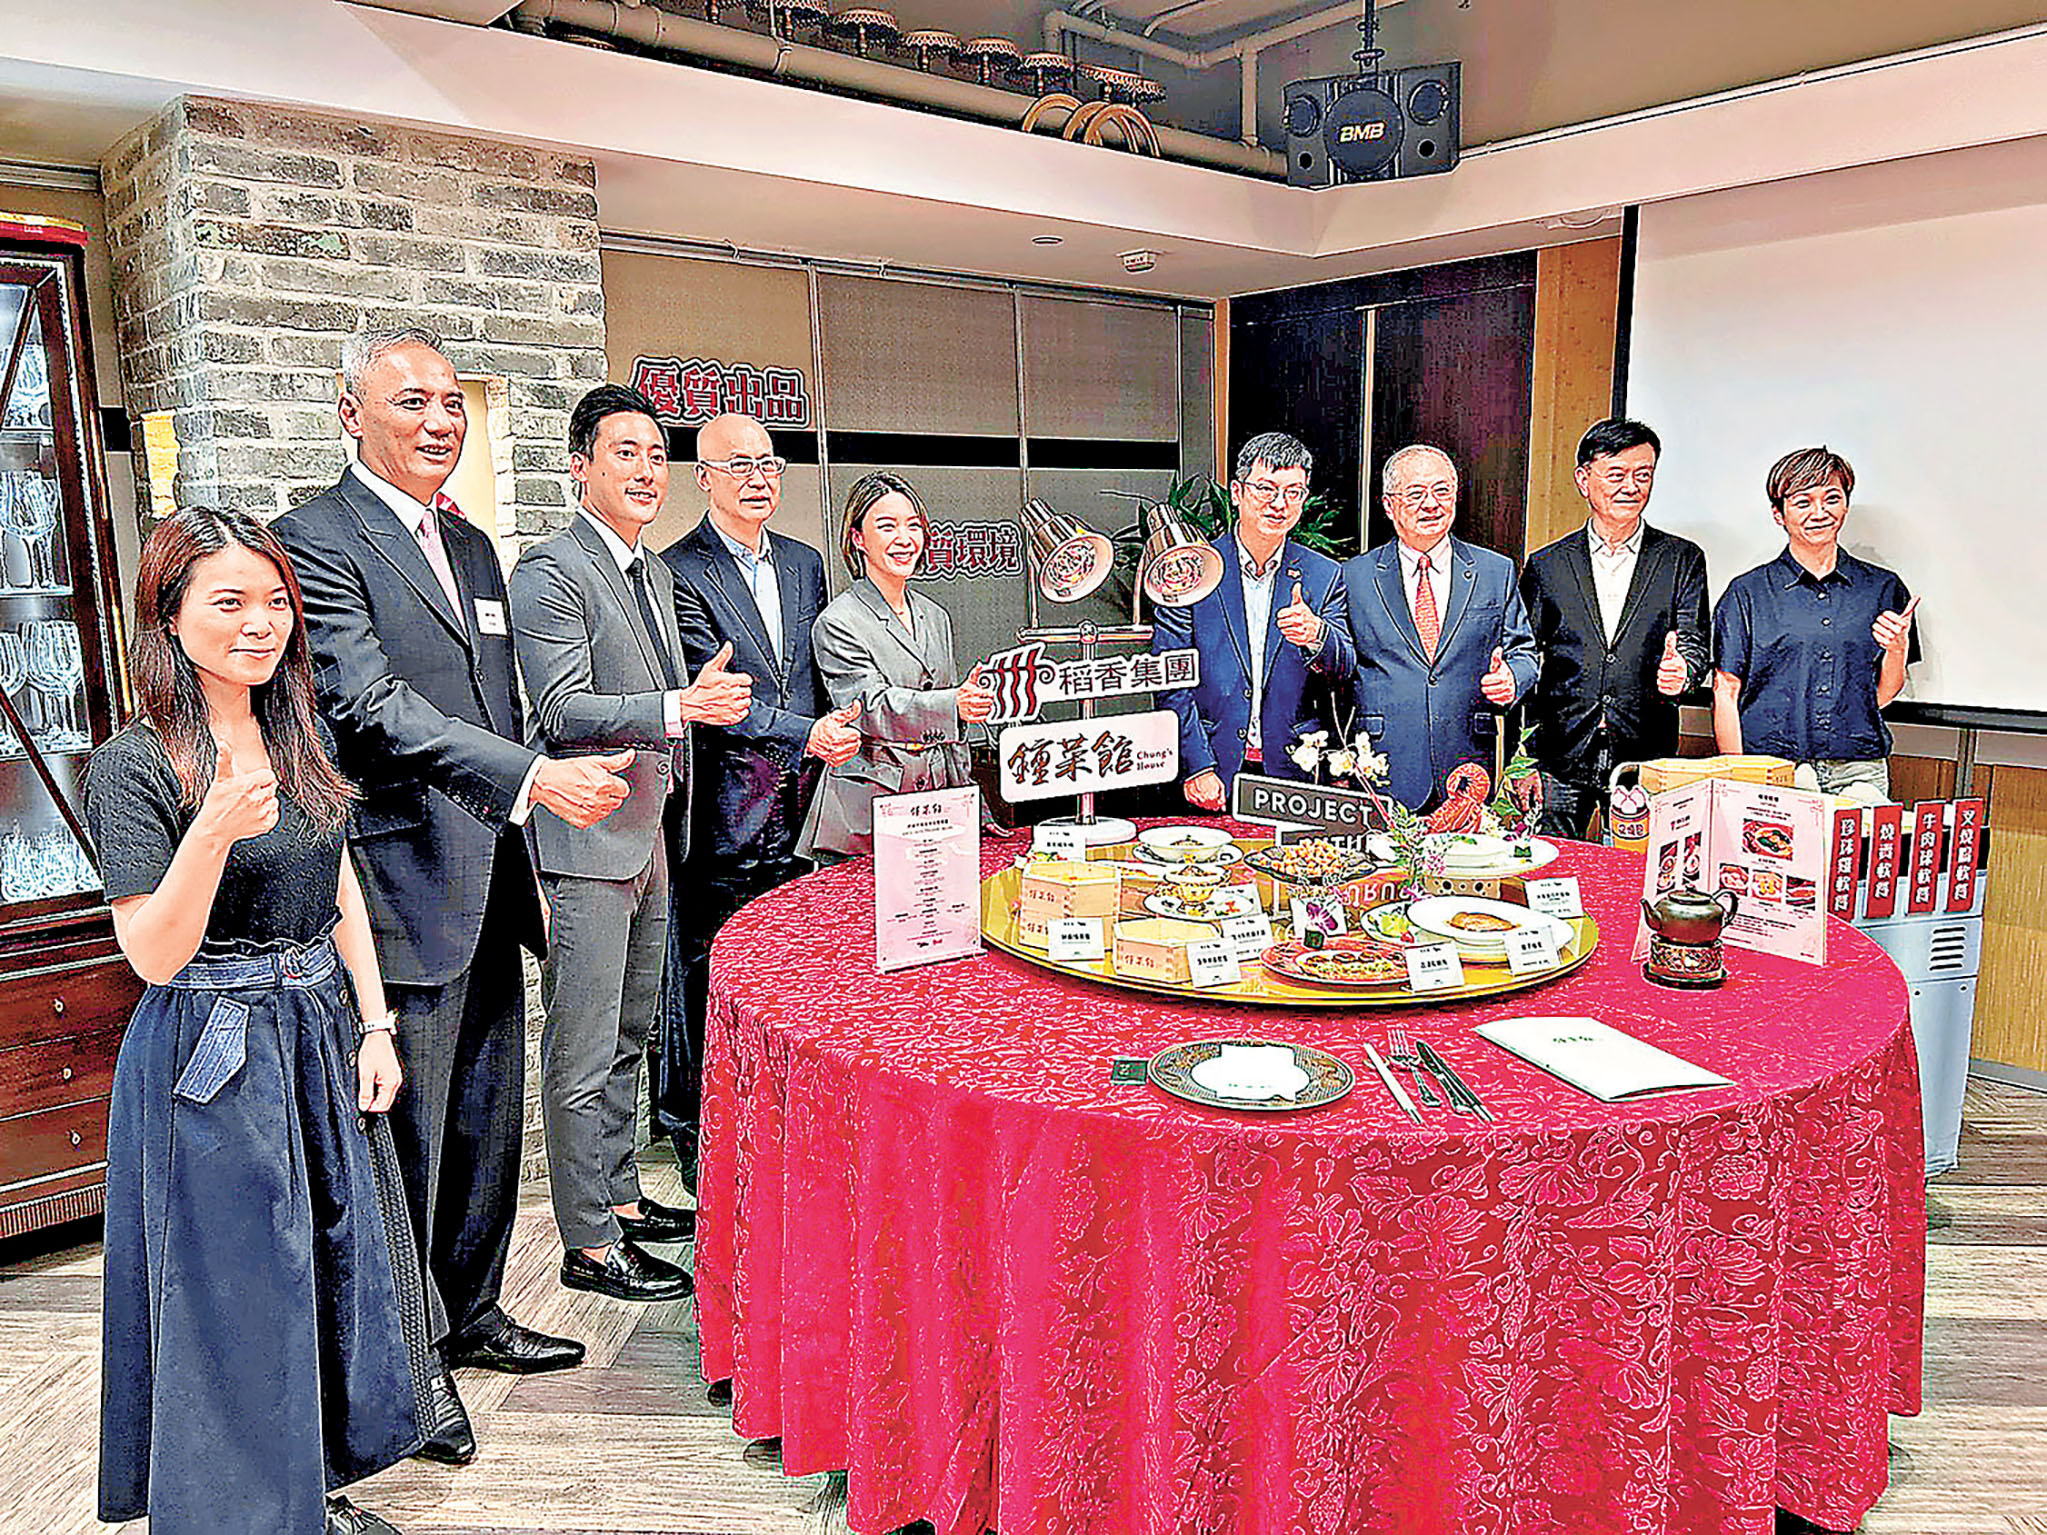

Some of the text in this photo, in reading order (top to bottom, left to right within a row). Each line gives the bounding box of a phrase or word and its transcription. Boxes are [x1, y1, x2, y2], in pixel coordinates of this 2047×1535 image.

[1339, 122, 1386, 143] BMB
[636, 365, 803, 419] 優質出品
[927, 528, 1018, 572] 質環境
[1058, 652, 1197, 696] 稻香集團
[1136, 748, 1173, 760] Chung's
[1136, 761, 1165, 771] House
[1253, 787, 1374, 827] PROJECT
